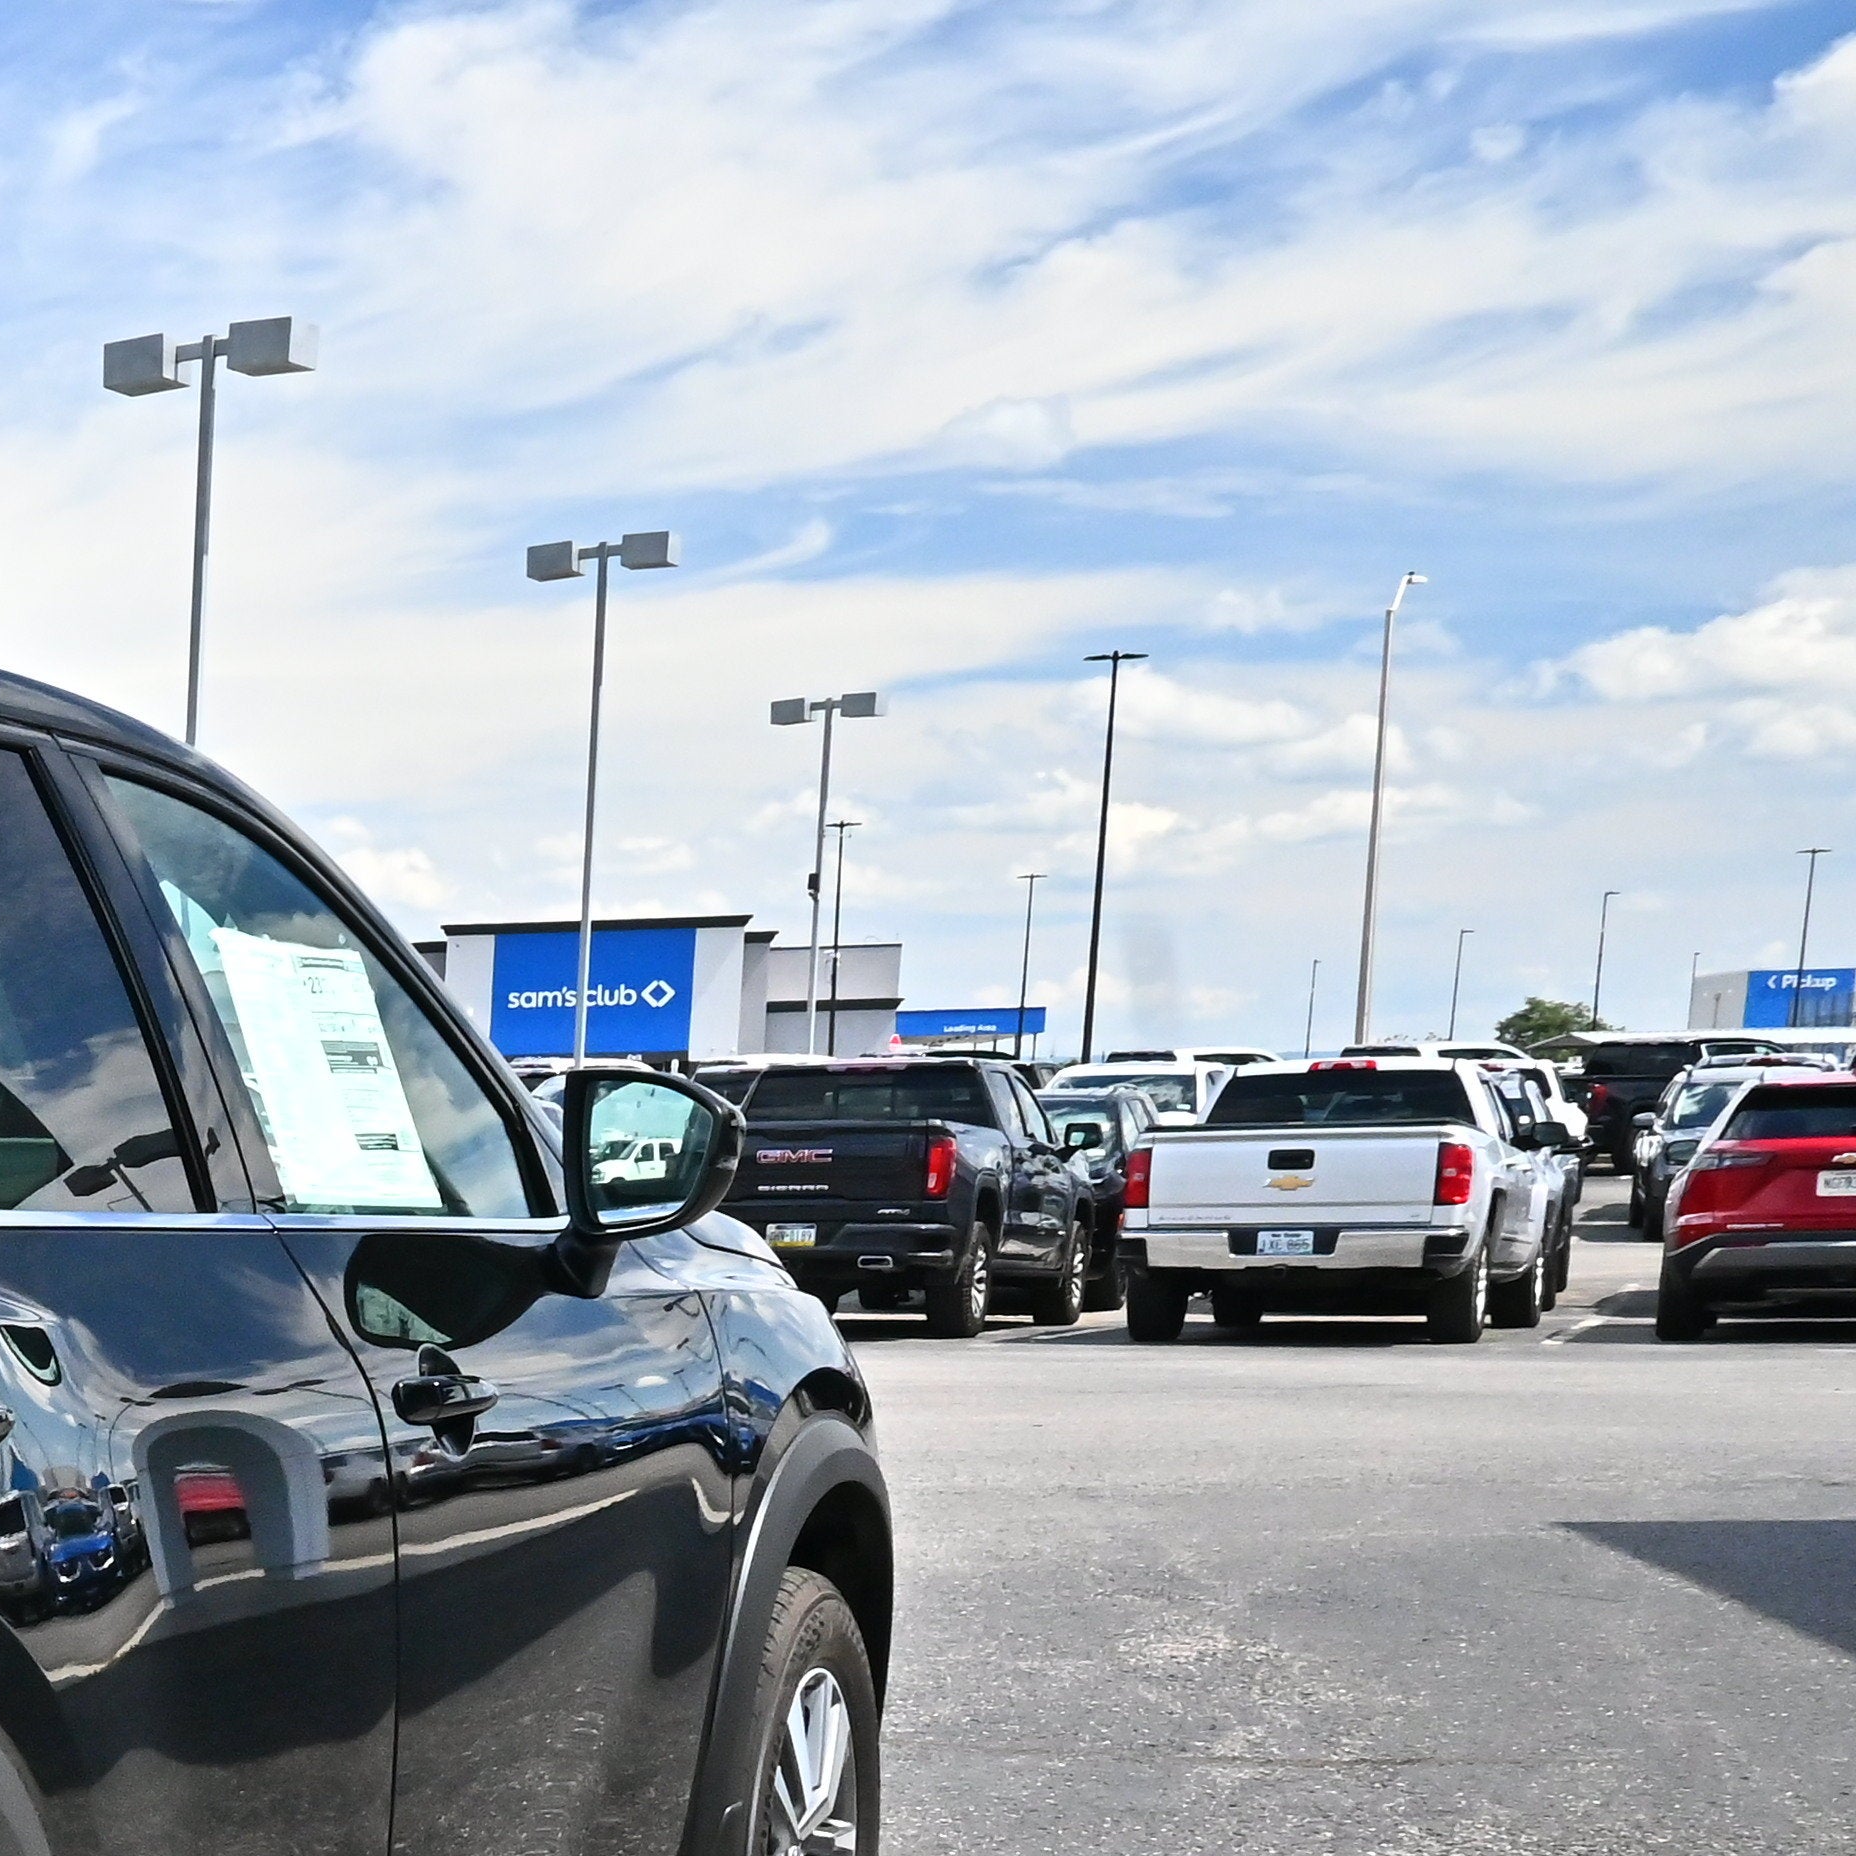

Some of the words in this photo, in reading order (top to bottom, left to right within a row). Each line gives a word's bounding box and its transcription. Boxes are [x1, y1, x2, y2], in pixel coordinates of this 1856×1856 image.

[507, 986, 577, 1009] sam's
[585, 984, 637, 1007] club
[756, 1149, 833, 1164] GMC
